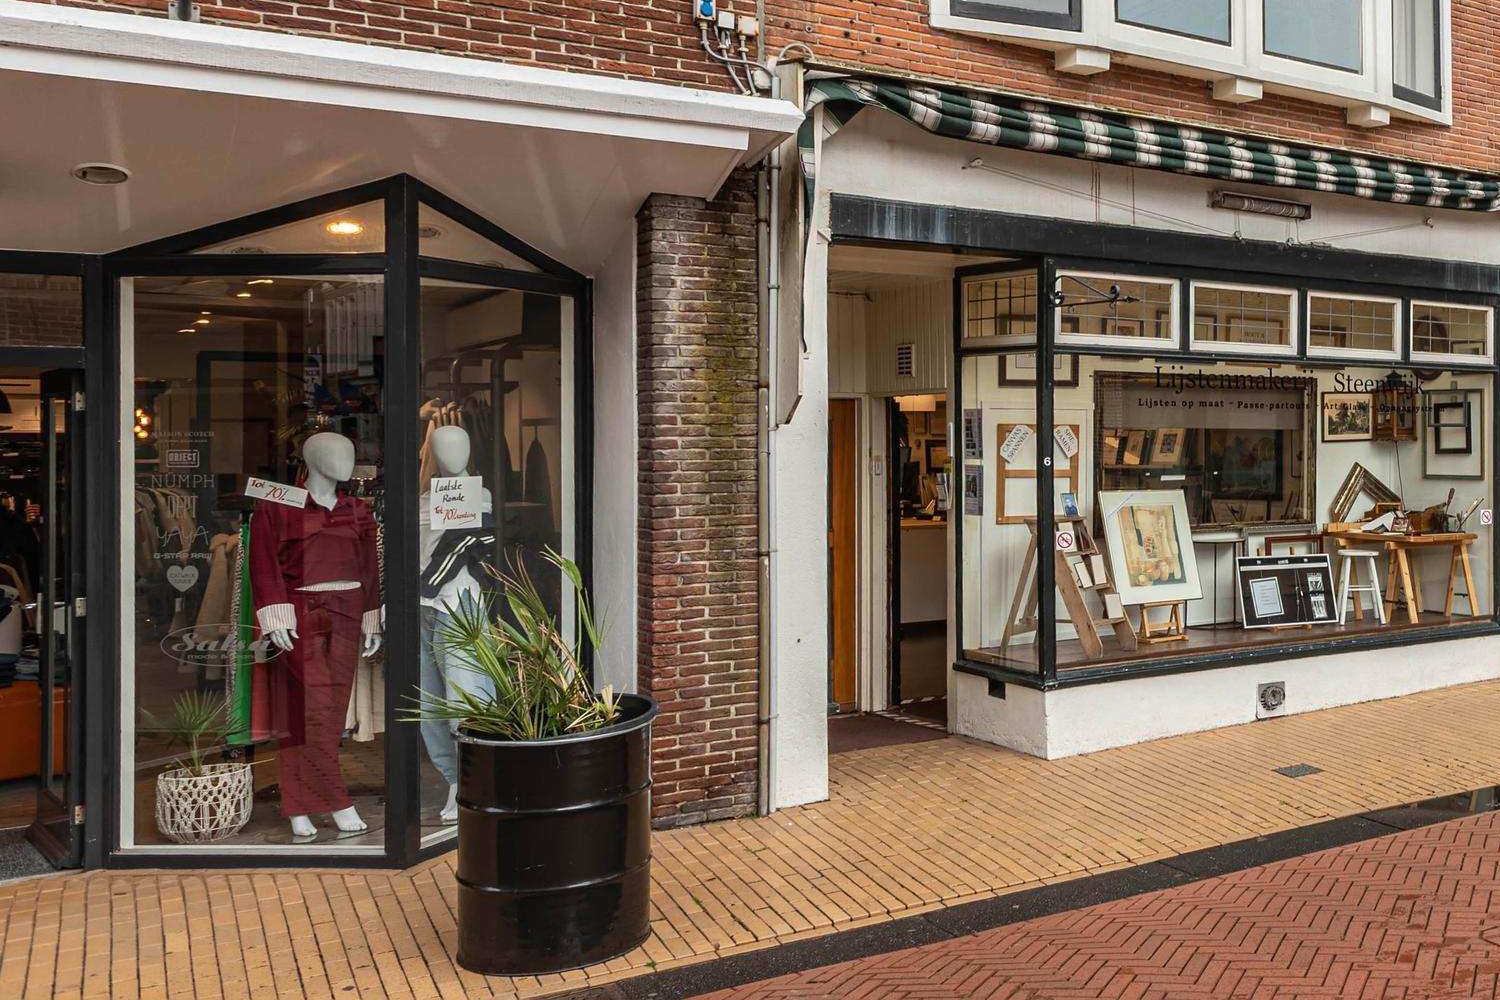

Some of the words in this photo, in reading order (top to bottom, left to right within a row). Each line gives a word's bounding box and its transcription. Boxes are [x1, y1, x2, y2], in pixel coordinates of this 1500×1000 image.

[1154, 365, 1314, 396] Lijstenmakerij
[1333, 371, 1426, 400] Steenwijk
[1138, 398, 1177, 408] Lijsten
[1181, 400, 1194, 408] op
[1199, 399, 1225, 408] maat
[1324, 402, 1338, 410] Art
[1002, 428, 1022, 453] CANVAS
[1008, 430, 1029, 459] SPANNEN
[168, 452, 197, 461] OBJECT
[1043, 456, 1052, 466] 6
[265, 485, 289, 501] 70%
[443, 492, 465, 503] Ronde
[171, 632, 275, 652] Salsa
